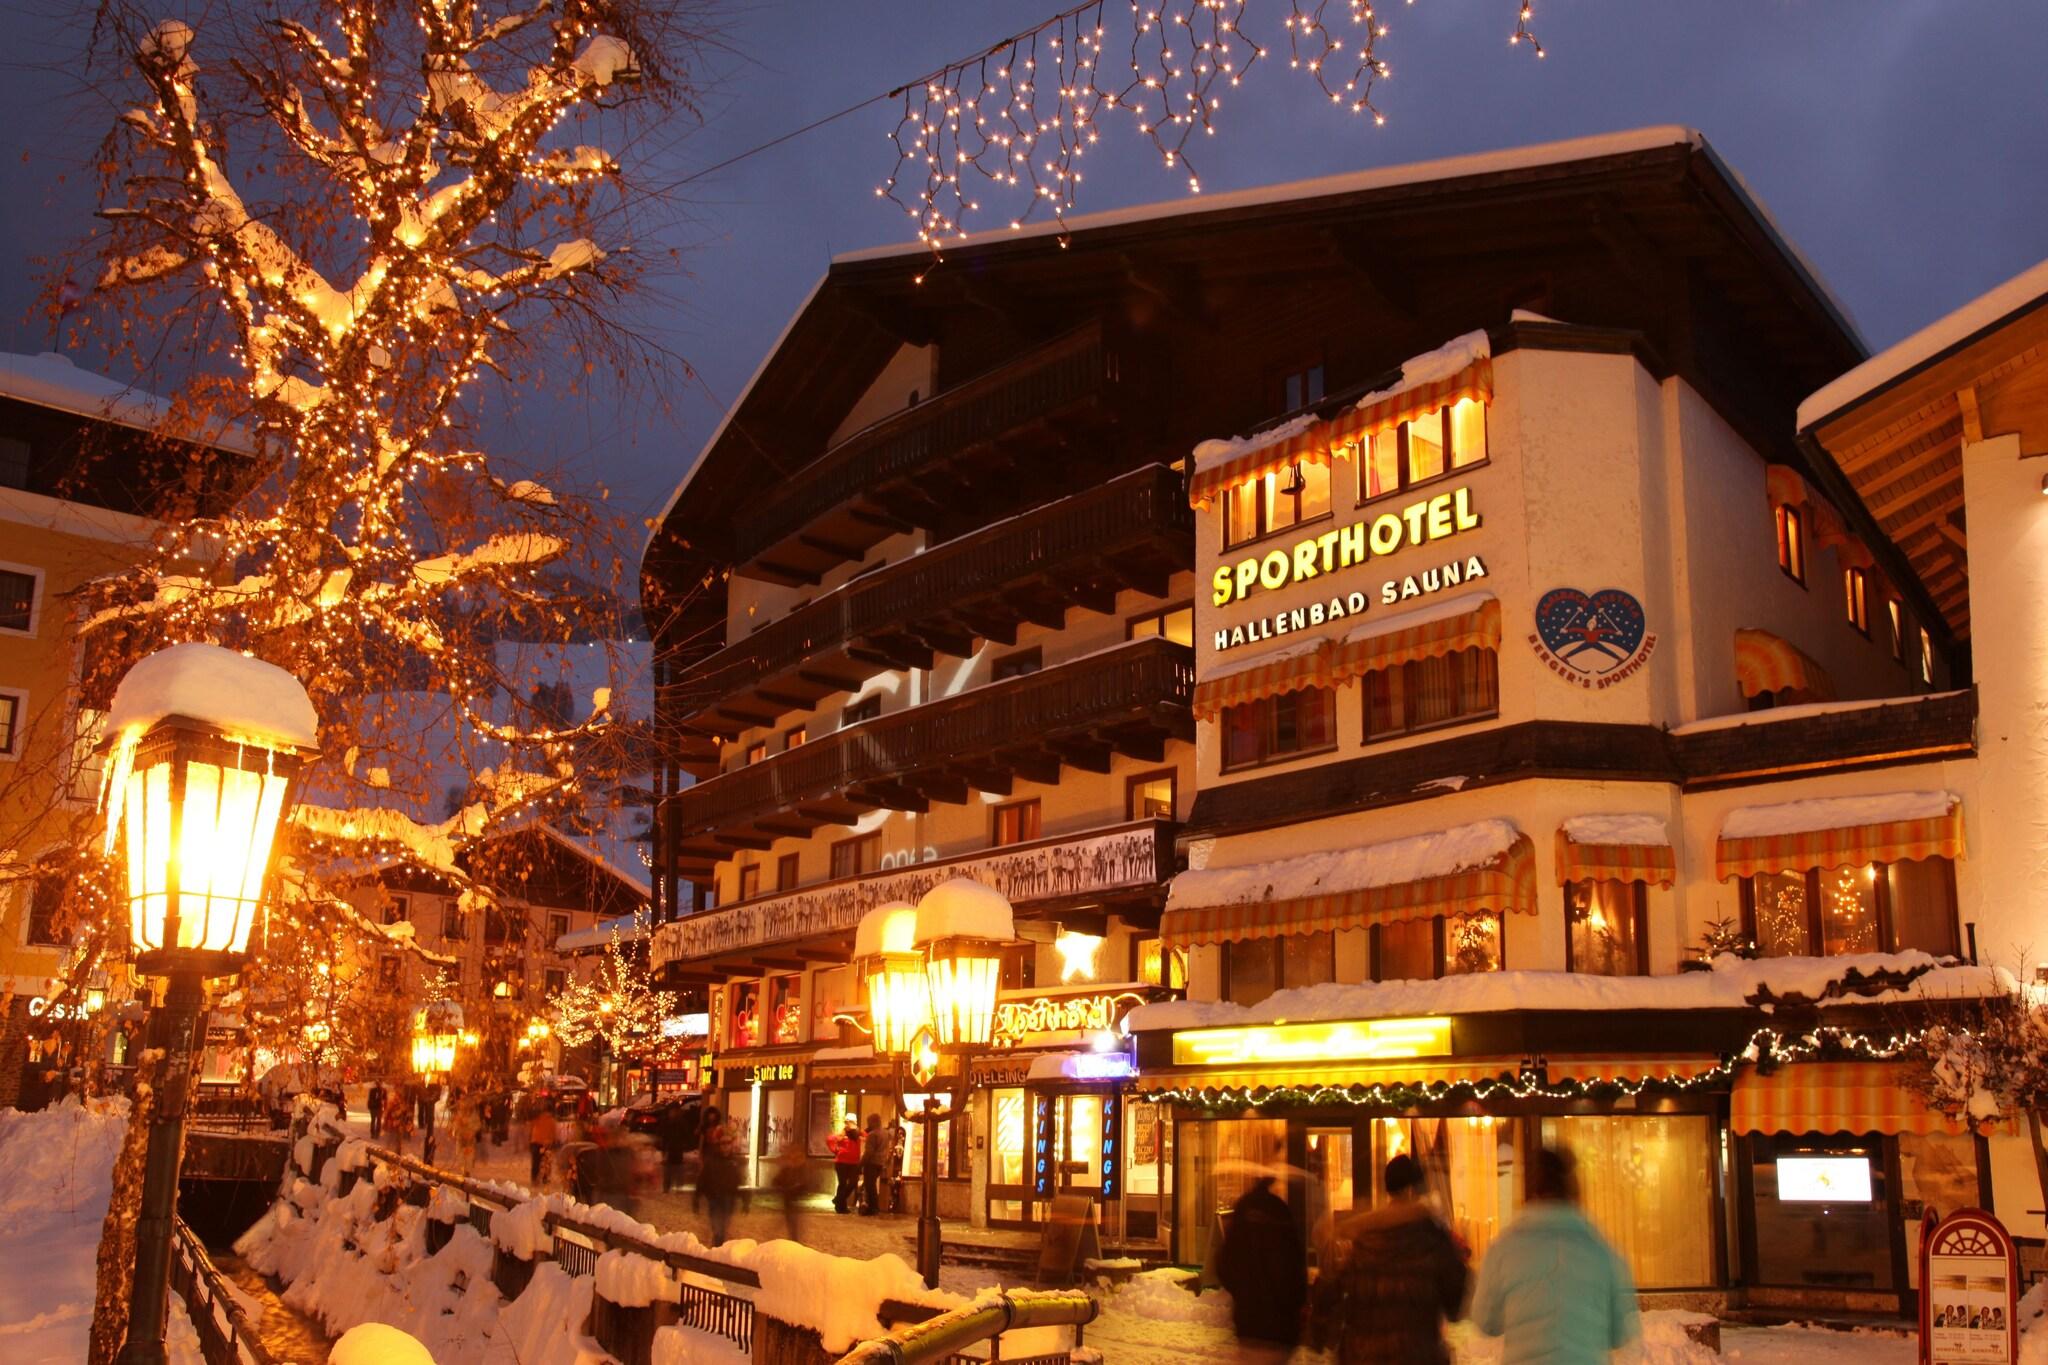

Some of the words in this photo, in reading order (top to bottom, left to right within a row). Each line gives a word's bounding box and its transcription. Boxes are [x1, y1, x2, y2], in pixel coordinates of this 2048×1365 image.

[1212, 487, 1479, 607] SPORTHOTEL
[1214, 592, 1366, 650] HALLENBAD
[1382, 556, 1486, 604] SAUNA
[1528, 634, 1591, 688] BERGER'S
[1597, 635, 1657, 689] SPORTHOTEL
[969, 1070, 1027, 1085] OTELEING
[1037, 1101, 1048, 1192] KINGS
[1103, 1100, 1113, 1194] KINGS
